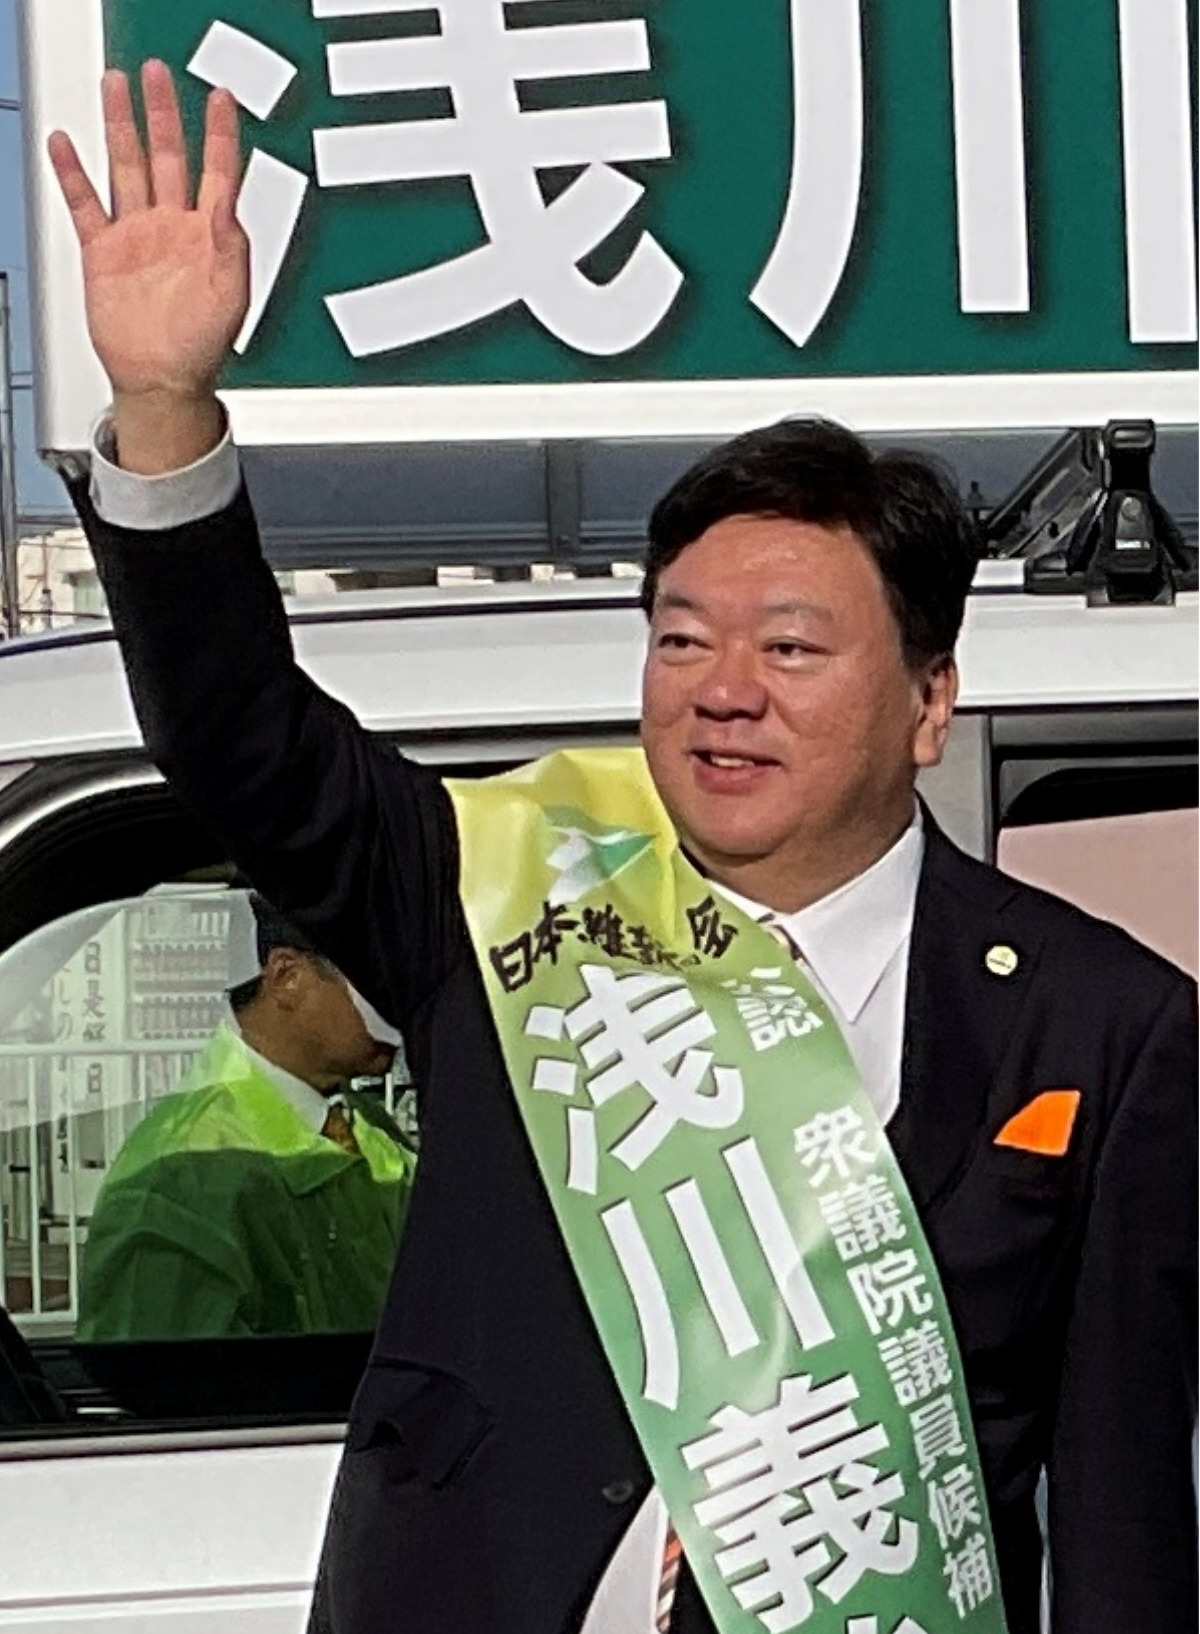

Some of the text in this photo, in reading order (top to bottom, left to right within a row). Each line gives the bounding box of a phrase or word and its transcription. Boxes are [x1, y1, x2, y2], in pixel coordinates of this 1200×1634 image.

[186, 0, 1198, 357] 浅川
[524, 963, 928, 1634] 浅川義
[794, 1105, 993, 1620] 衆議院議員候補
